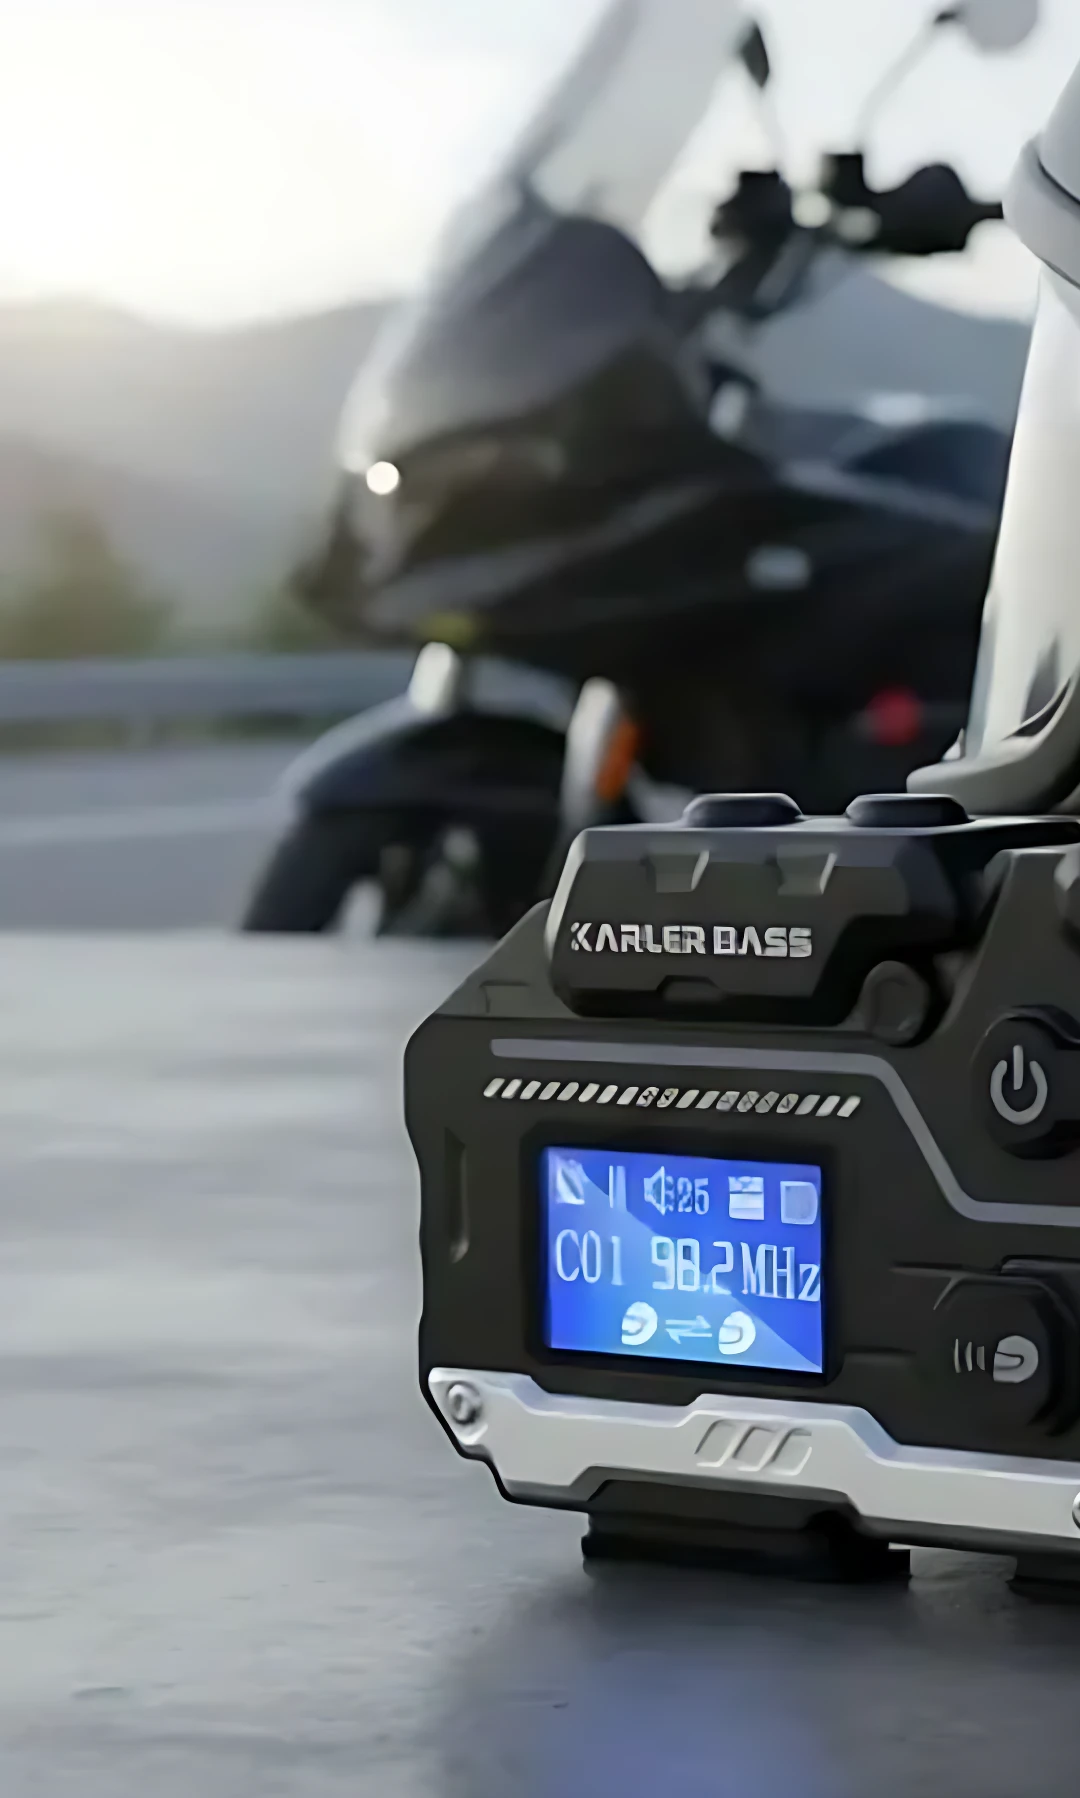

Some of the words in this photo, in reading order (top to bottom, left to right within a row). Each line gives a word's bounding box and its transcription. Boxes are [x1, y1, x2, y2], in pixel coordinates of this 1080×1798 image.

[570, 921, 706, 955] KARLER
[713, 925, 812, 958] BASS
[555, 1228, 624, 1285] C01
